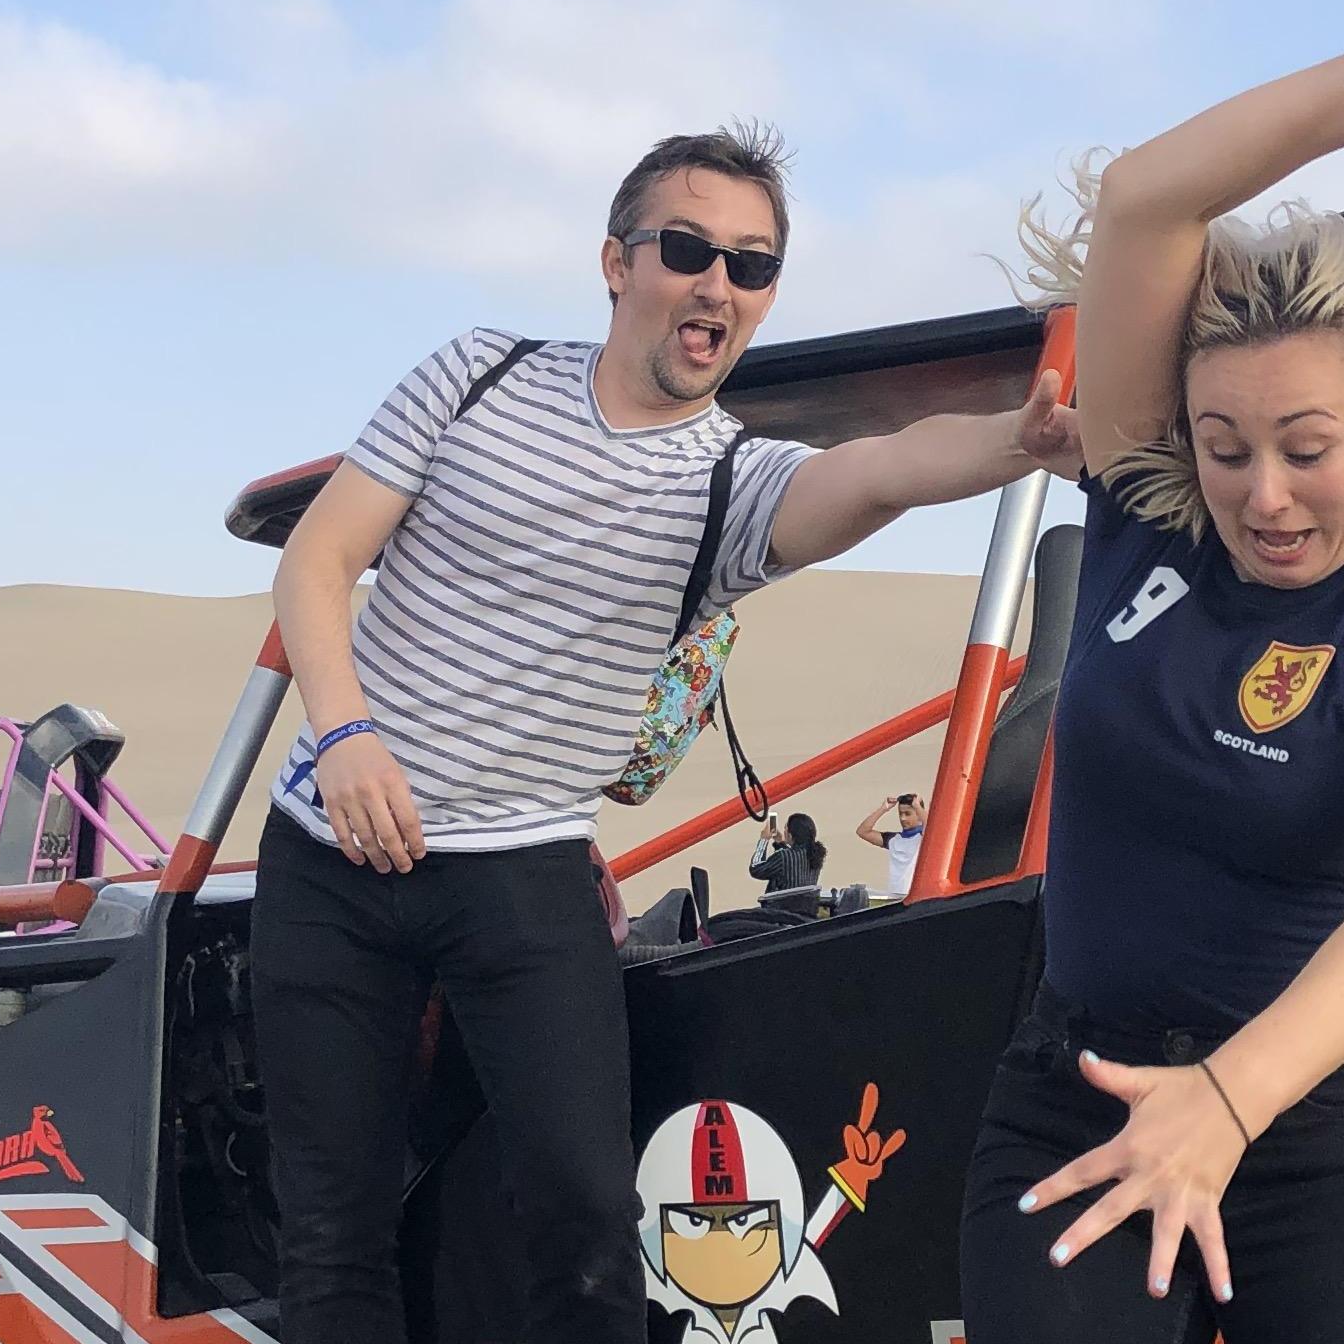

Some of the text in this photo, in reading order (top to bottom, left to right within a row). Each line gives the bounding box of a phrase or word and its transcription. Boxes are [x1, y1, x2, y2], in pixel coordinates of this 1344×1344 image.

[1106, 566, 1190, 643] 9
[1213, 729, 1290, 763] SCOTLAND
[703, 1105, 736, 1196] ALEM
